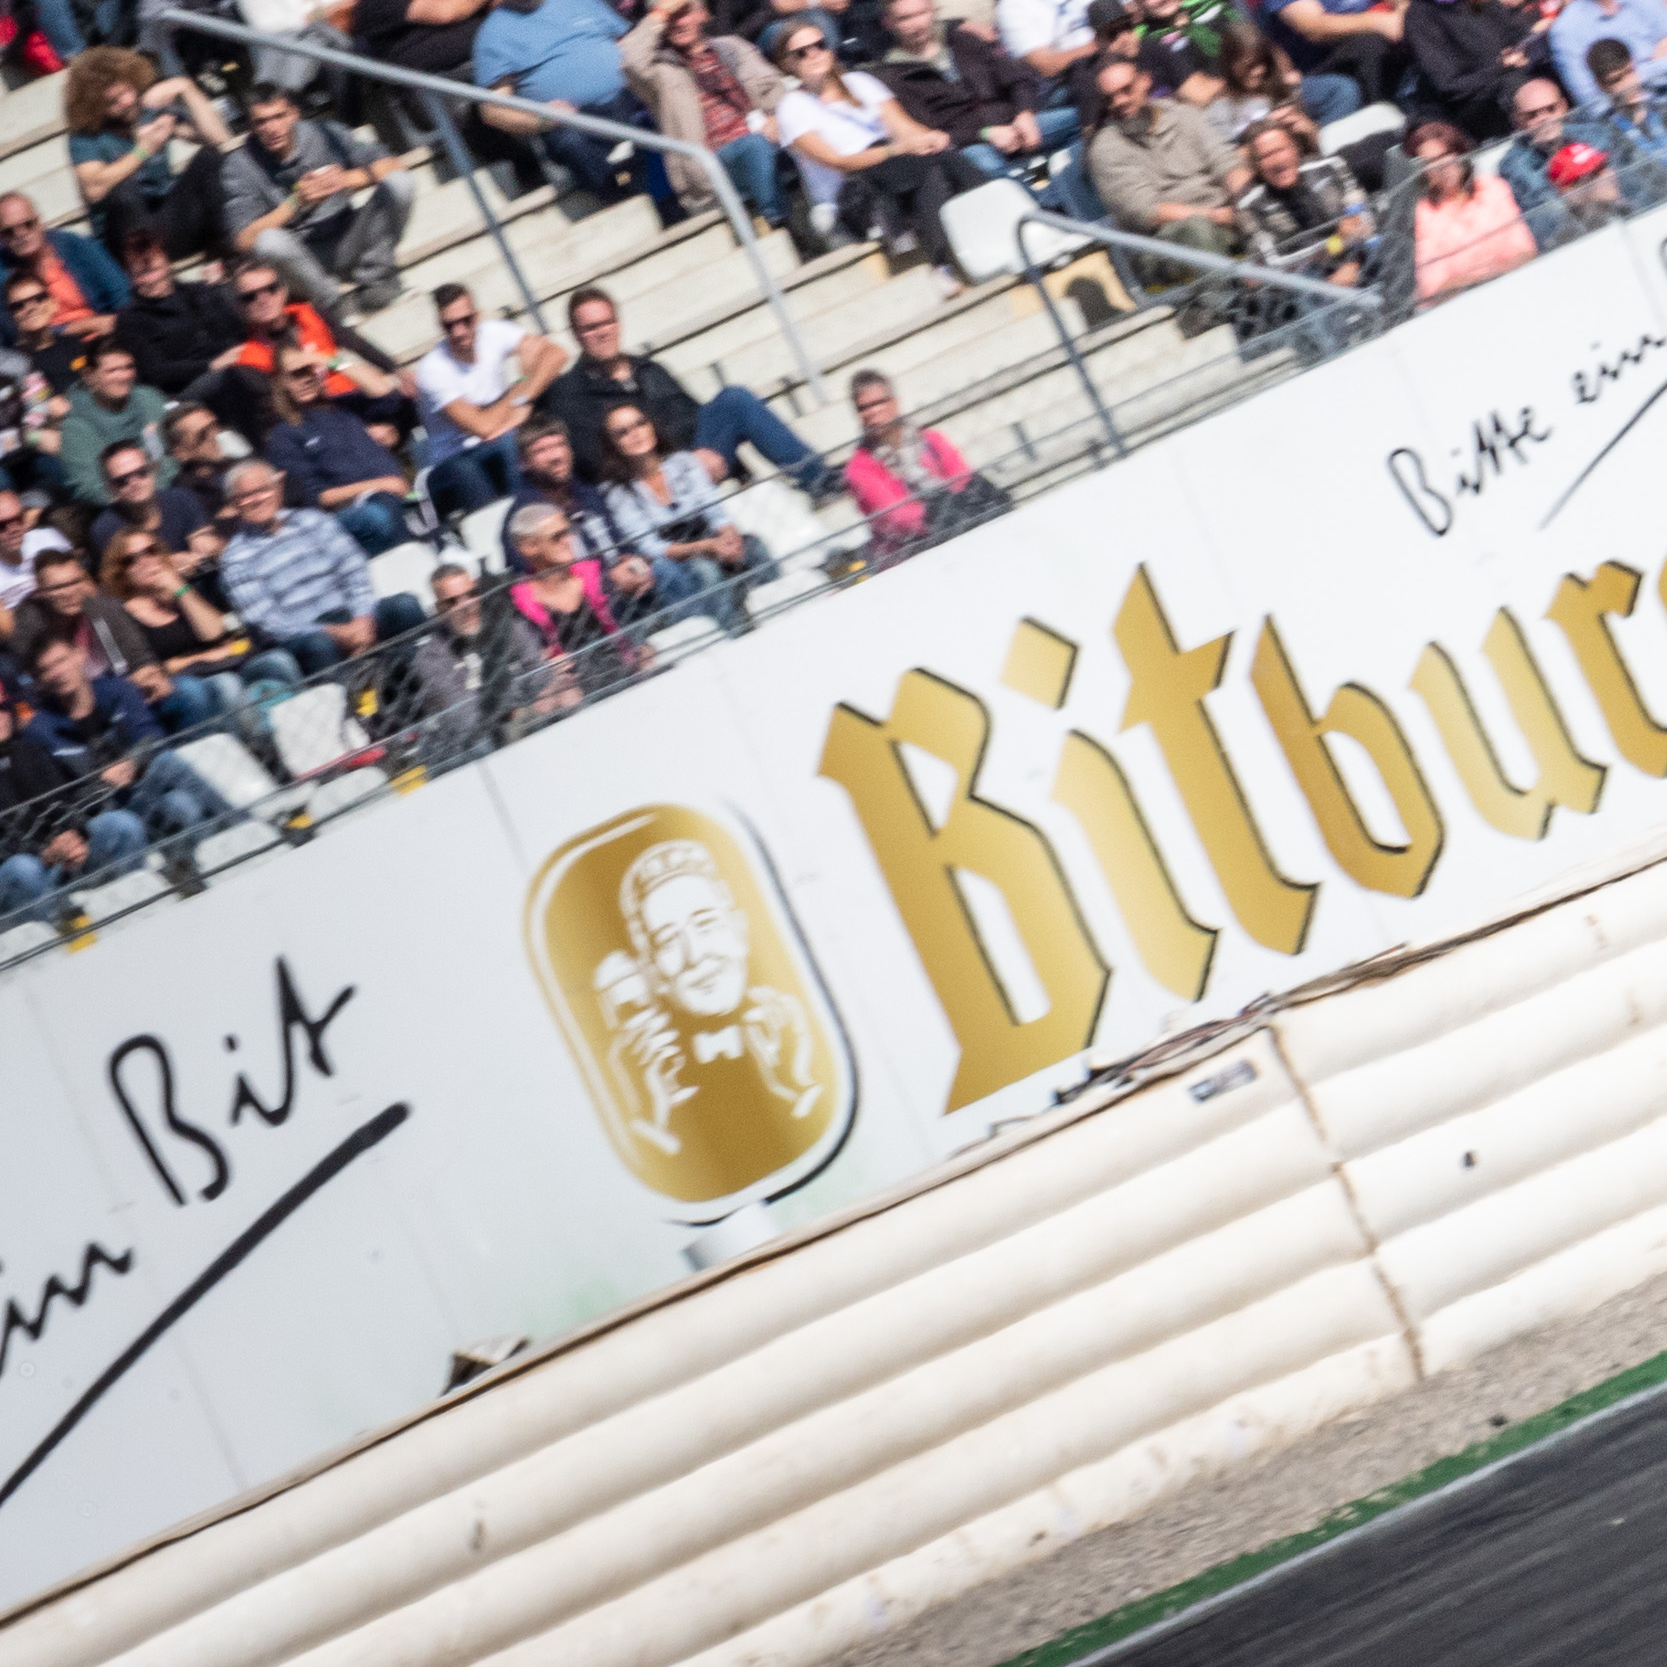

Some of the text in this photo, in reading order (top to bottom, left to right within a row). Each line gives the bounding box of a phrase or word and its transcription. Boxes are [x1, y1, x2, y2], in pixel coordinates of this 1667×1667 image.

[1387, 410, 1553, 536] Bitte
[1574, 332, 1666, 406] ein
[0, 953, 358, 1377] in Bit
